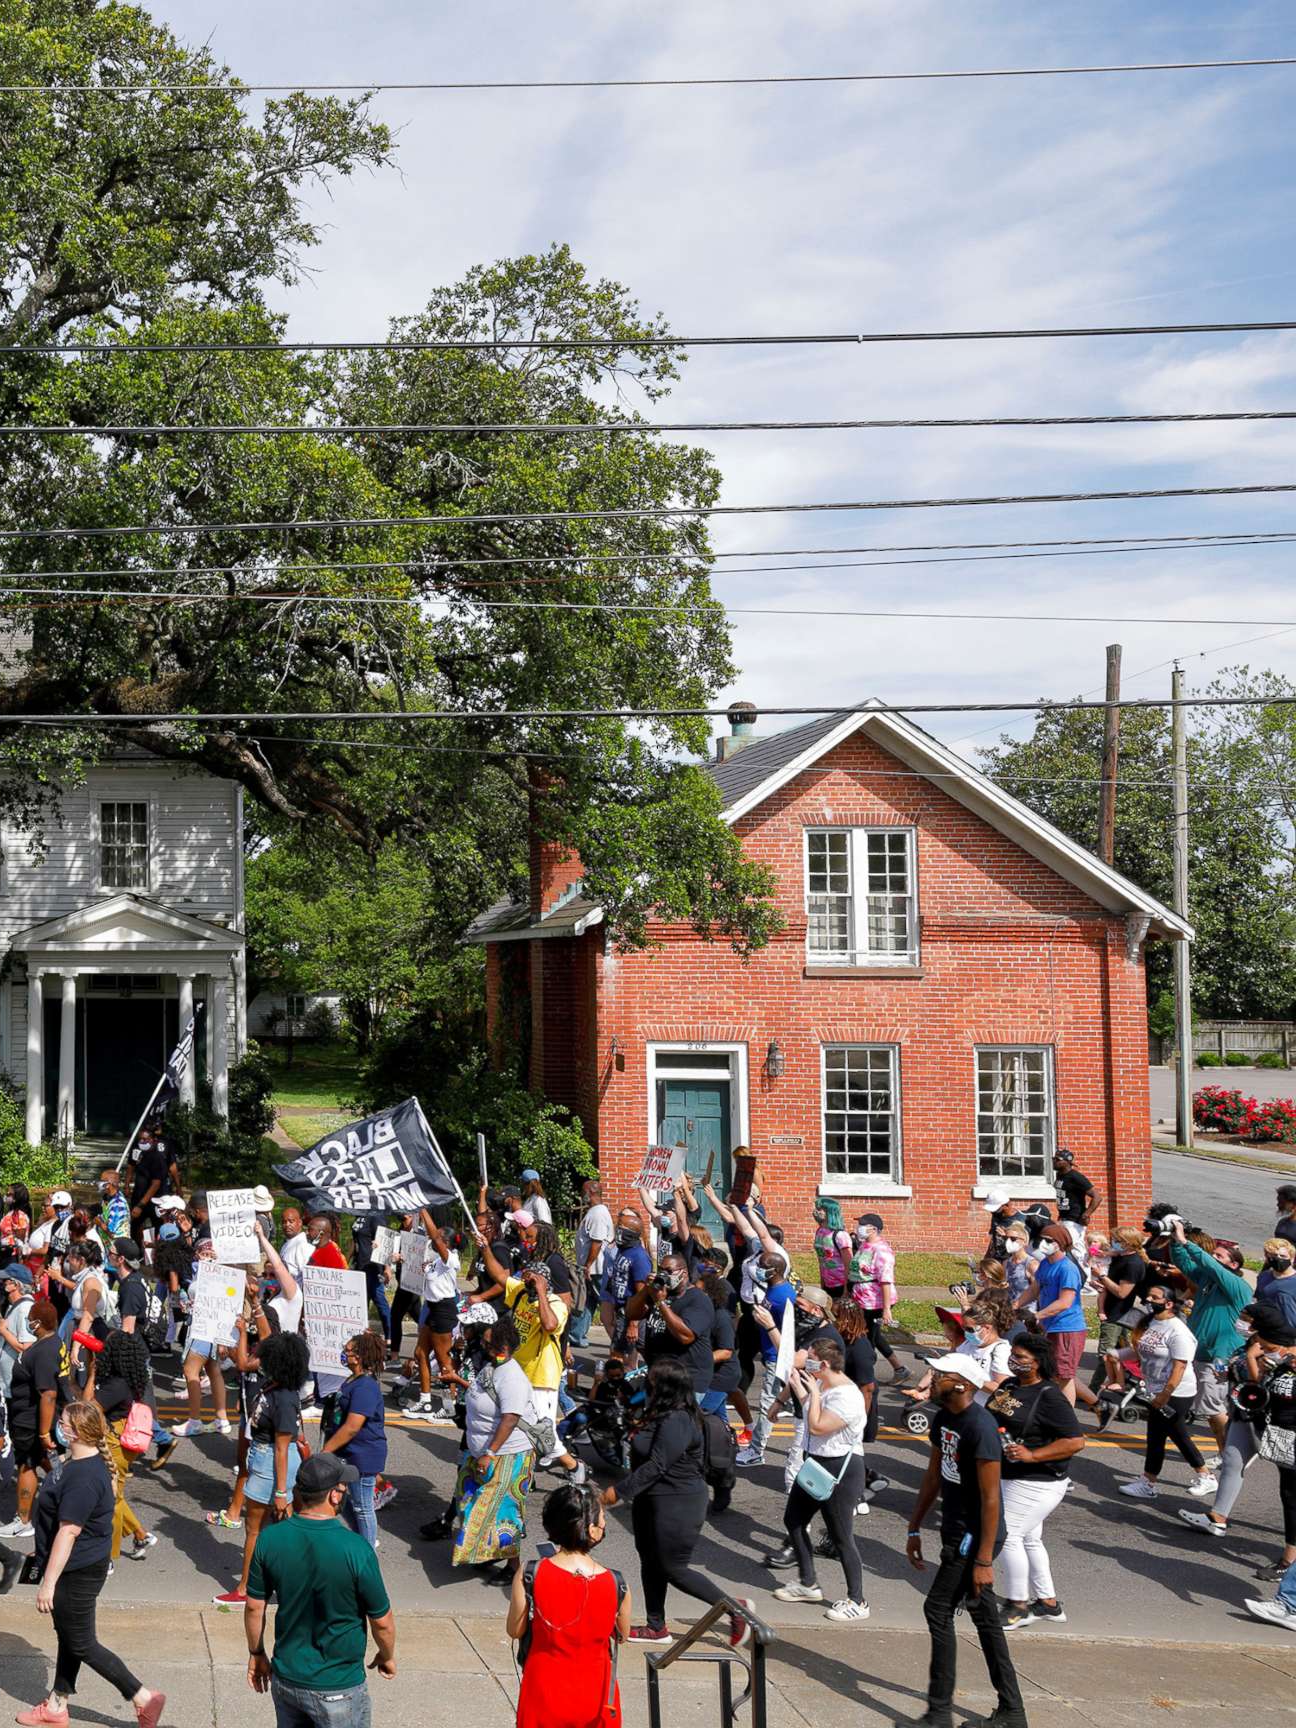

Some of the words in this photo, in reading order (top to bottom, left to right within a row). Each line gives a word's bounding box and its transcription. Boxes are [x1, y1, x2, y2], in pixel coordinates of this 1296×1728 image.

[208, 1192, 254, 1209] RELEASE
[217, 1211, 247, 1225] THE
[212, 1225, 252, 1239] VIDEO
[305, 1267, 315, 1280] IF
[317, 1269, 329, 1281] YOU
[330, 1270, 344, 1284] ARE
[305, 1284, 333, 1298] NEUTRAL
[305, 1301, 361, 1320] INJUSTICE
